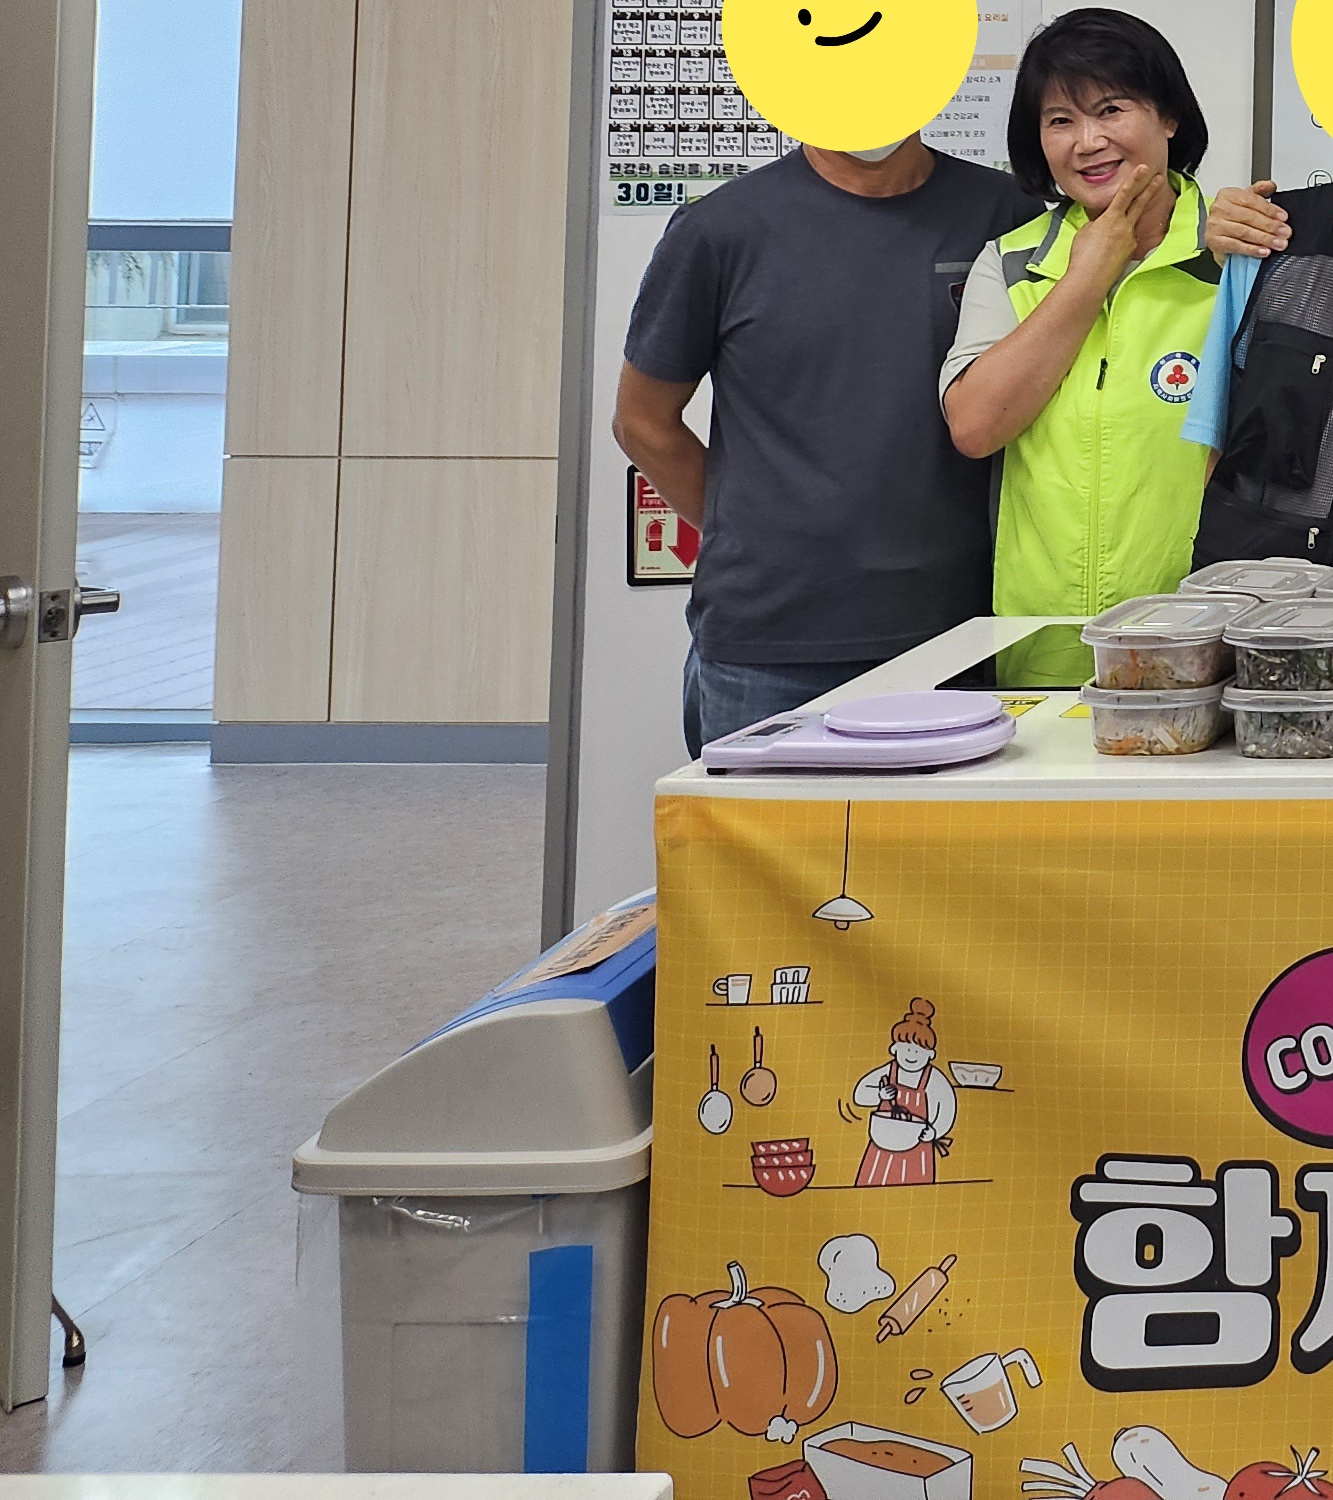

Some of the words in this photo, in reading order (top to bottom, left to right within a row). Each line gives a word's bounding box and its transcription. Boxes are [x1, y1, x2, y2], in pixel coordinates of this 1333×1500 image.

[653, 123, 666, 132] 26
[688, 123, 700, 132] 27
[610, 163, 651, 176] 건강한
[658, 163, 701, 176] 습관을
[708, 163, 749, 176] 기르는
[618, 183, 684, 203] 30일!
